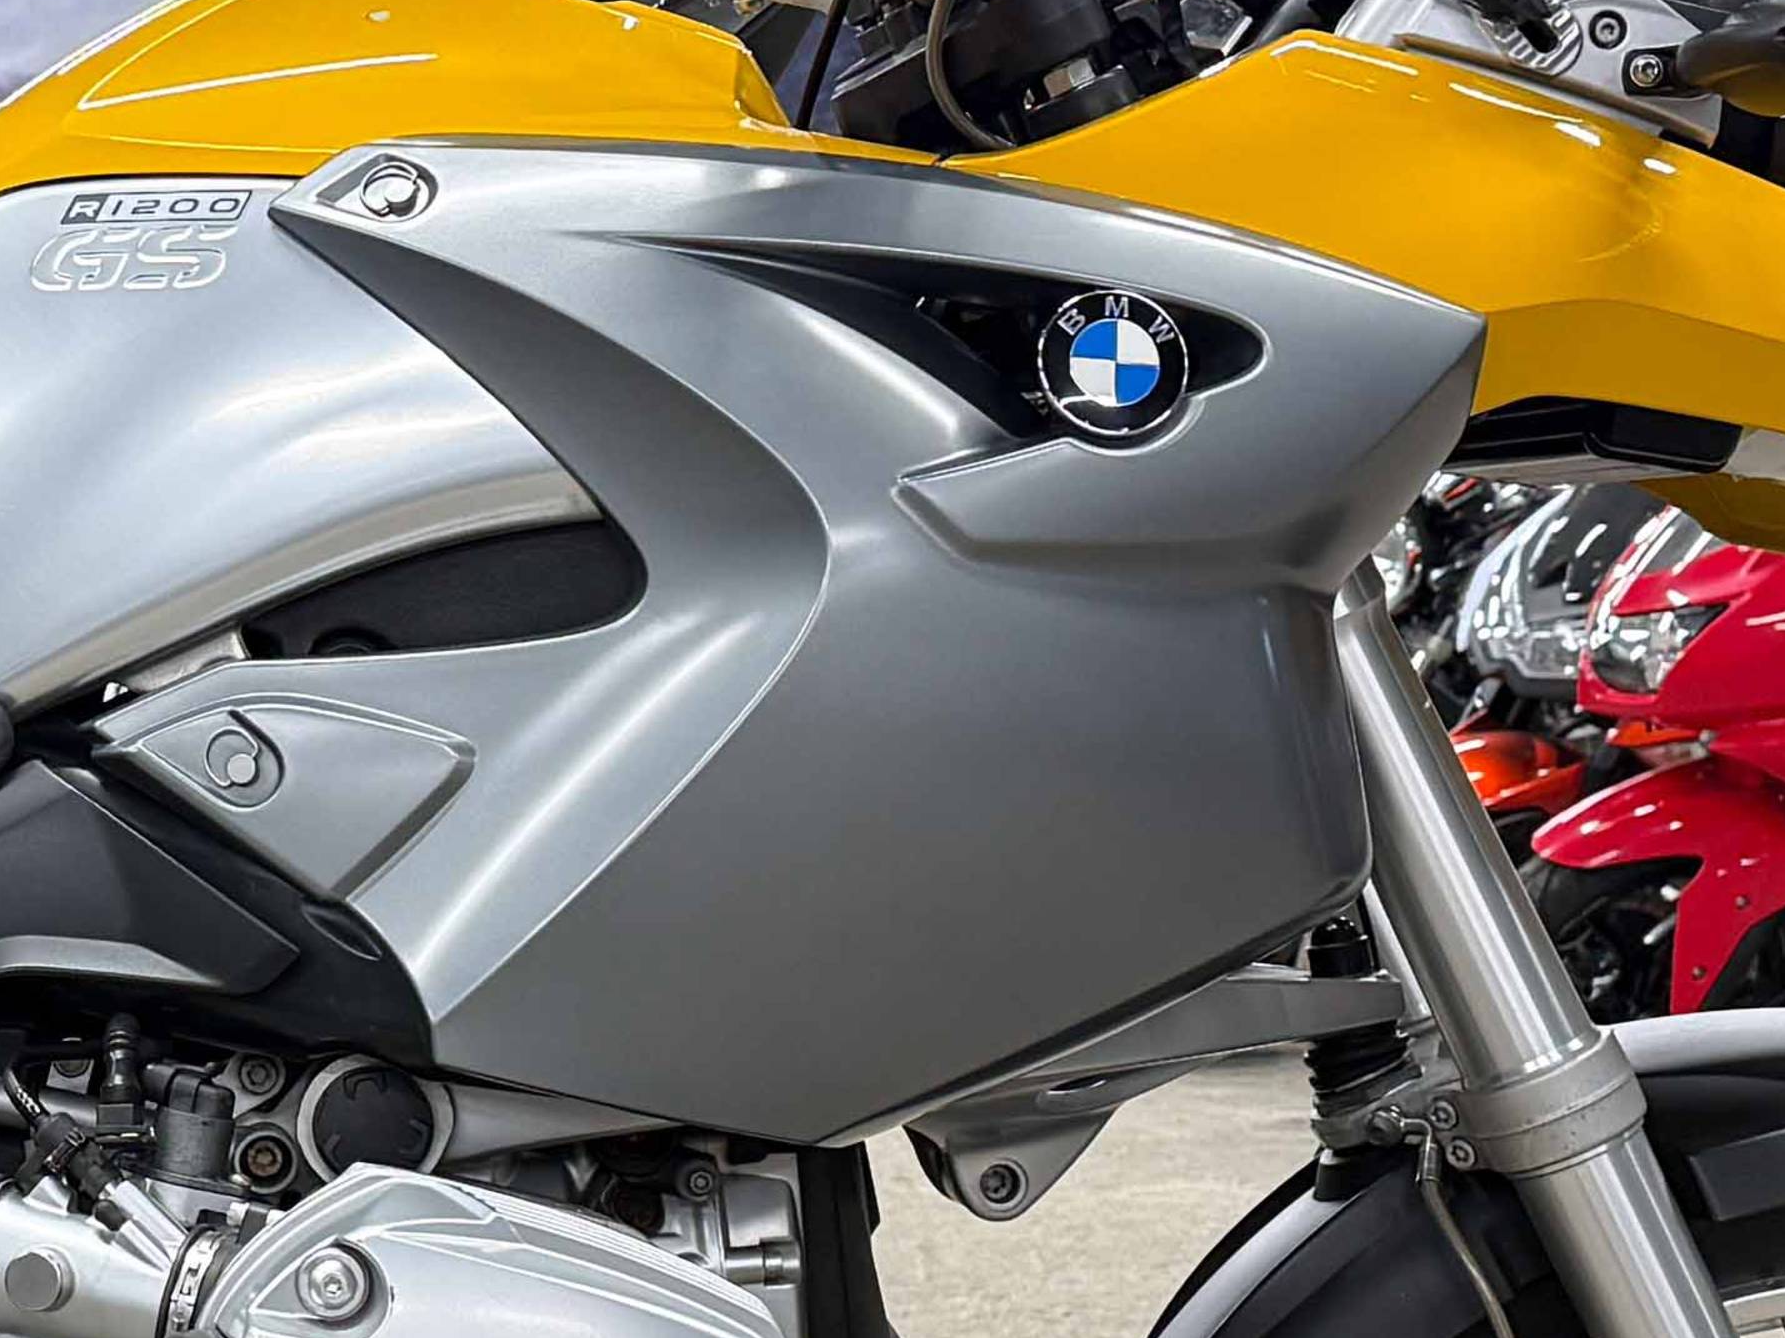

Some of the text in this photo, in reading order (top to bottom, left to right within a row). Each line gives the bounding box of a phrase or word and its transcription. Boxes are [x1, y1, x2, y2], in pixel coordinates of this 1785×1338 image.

[67, 196, 244, 220] R1200
[31, 224, 240, 292] GS
[1057, 295, 1175, 344] BMW
